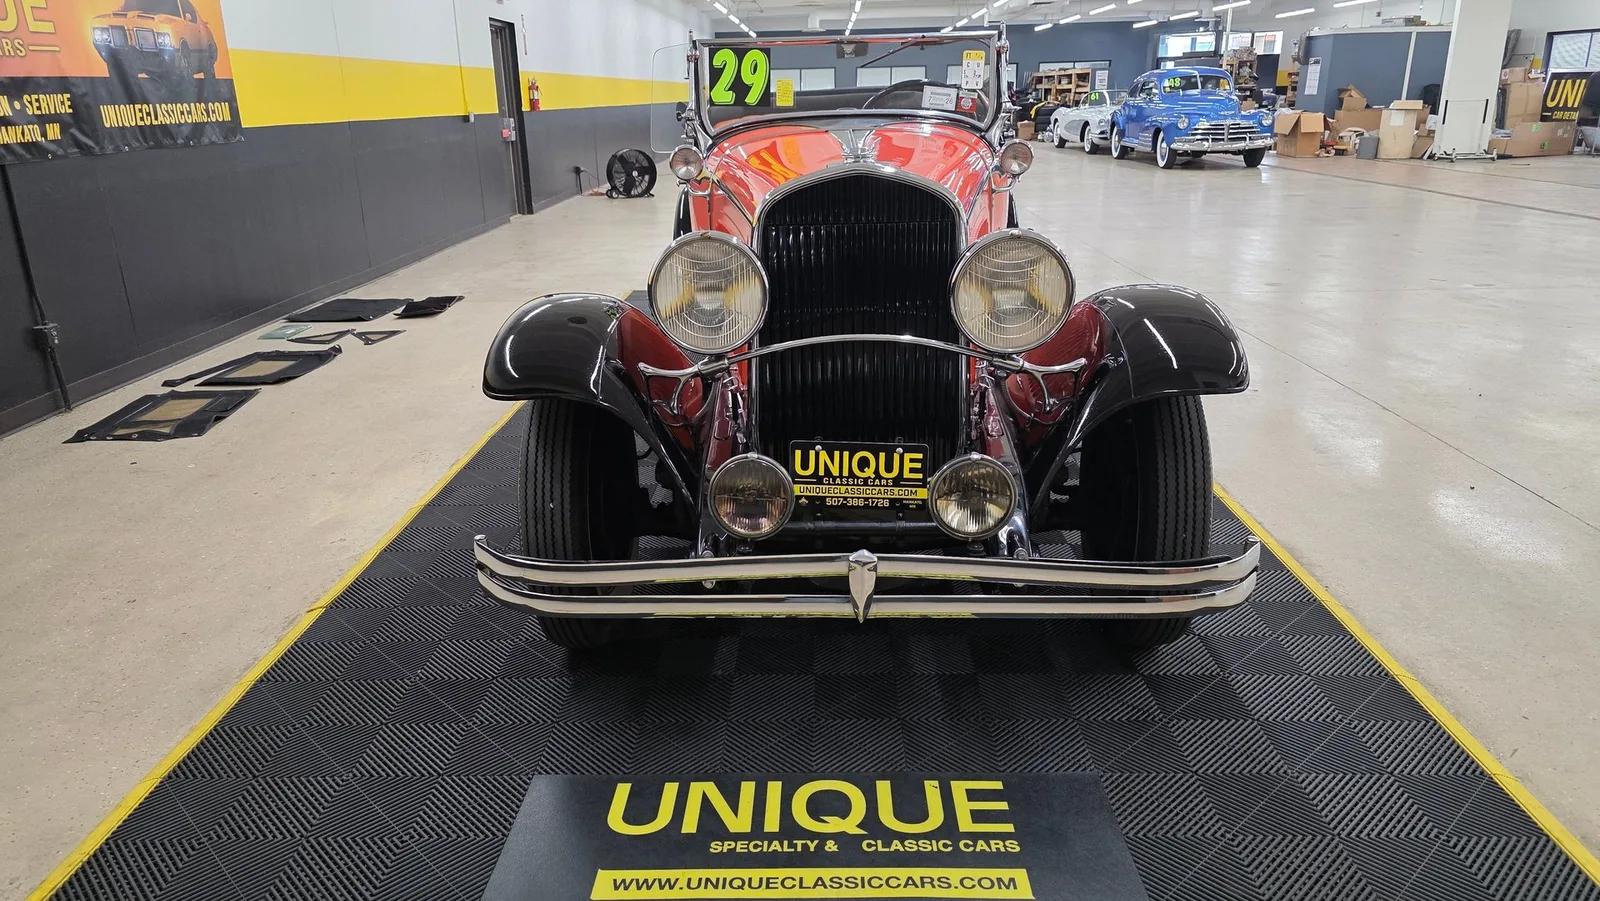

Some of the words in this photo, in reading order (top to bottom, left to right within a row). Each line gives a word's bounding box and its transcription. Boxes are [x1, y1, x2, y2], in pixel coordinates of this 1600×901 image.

[0, 38, 26, 57] RS
[711, 48, 769, 105] 29
[1090, 92, 1099, 101] 61
[1546, 79, 1586, 107] UNI
[23, 93, 73, 115] SERVICE
[100, 102, 231, 127] UNIQUECLASSICCARS.COM
[45, 122, 61, 140] MN
[794, 449, 924, 479] UNIQUE
[823, 477, 864, 486] CLASSIC
[867, 478, 894, 486] CARS
[799, 486, 918, 497] UNIQUECLASSICCARS.COM
[825, 497, 890, 507] 507-386-1726
[607, 780, 1016, 836] UNIQUE
[709, 839, 820, 853] SPECIALTY
[824, 839, 839, 852] &
[861, 839, 953, 852] CLASSIC
[958, 839, 1021, 853] CARS
[612, 876, 1018, 891] WWW.UNIQUECLASSICCARS.COM
